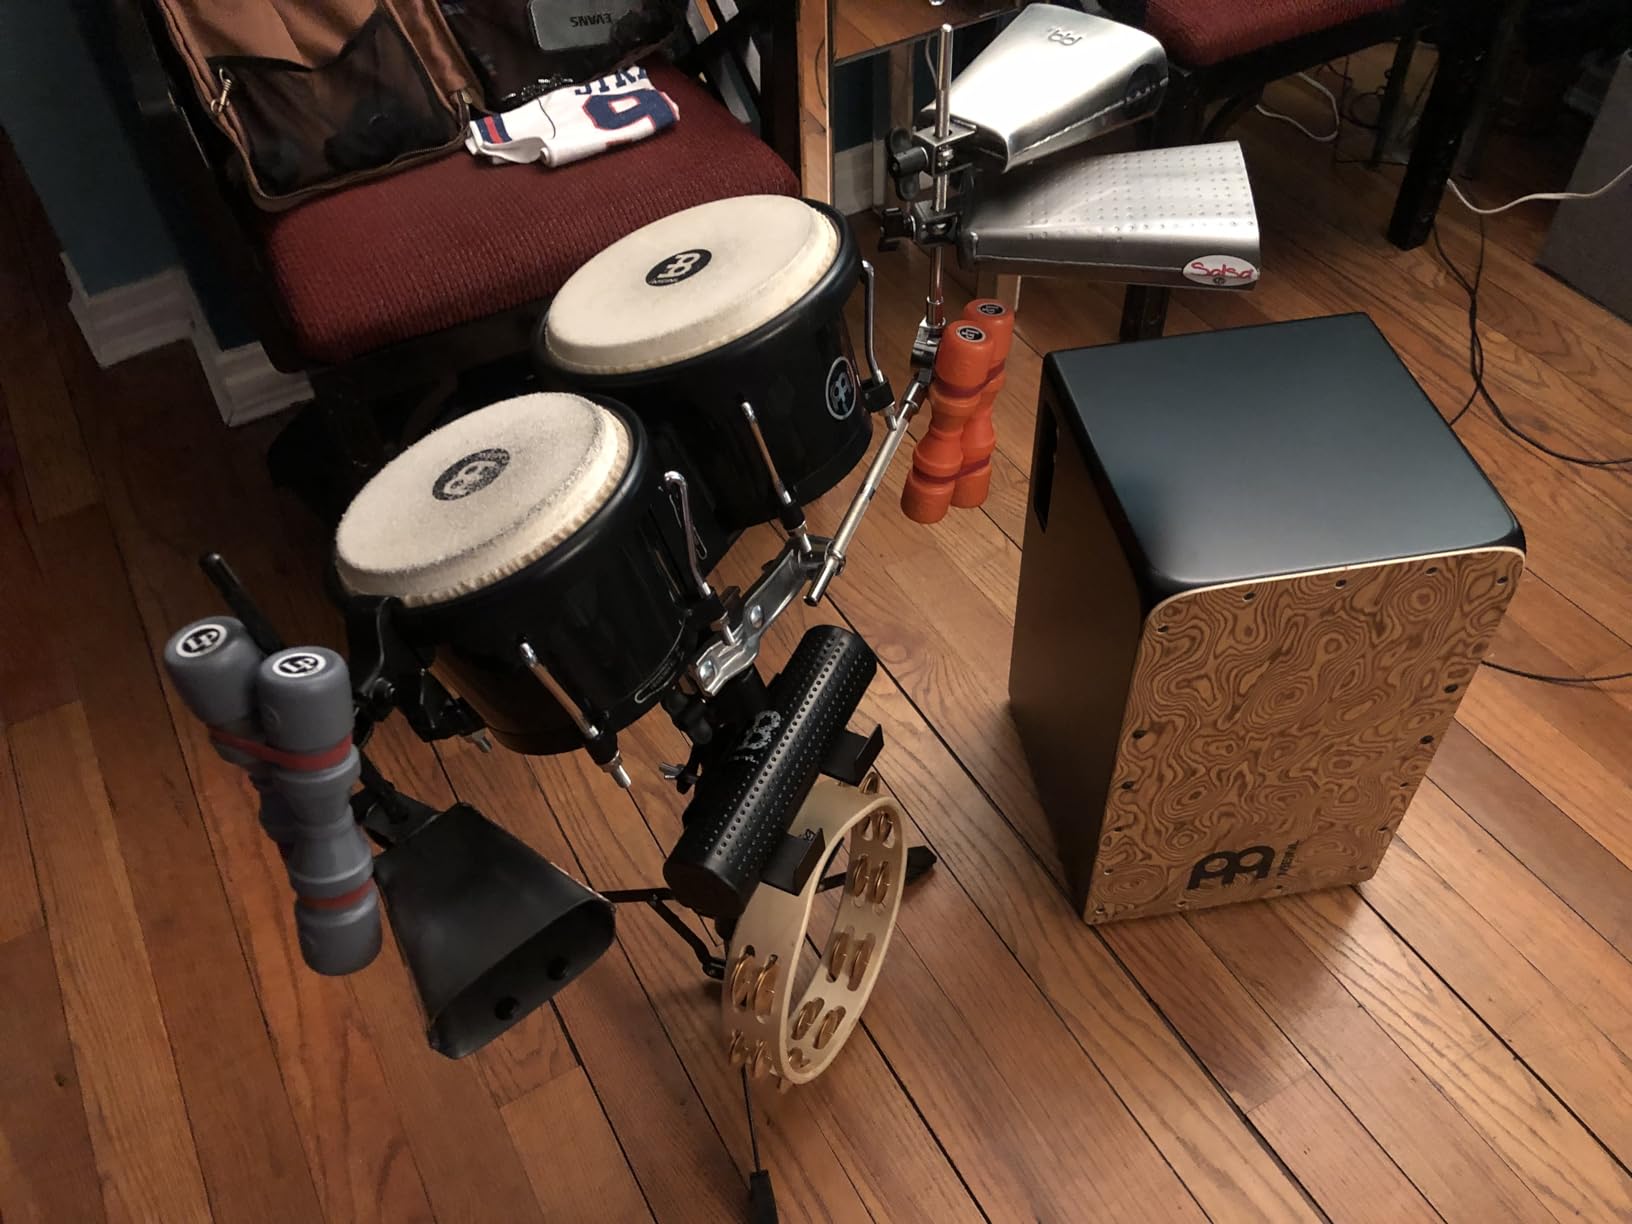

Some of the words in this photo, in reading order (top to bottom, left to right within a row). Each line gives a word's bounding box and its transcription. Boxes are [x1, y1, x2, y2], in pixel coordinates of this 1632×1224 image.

[570, 13, 613, 28] EVANS
[1190, 261, 1255, 279] Salsa
[183, 628, 221, 652] LP
[278, 655, 320, 673] LP
